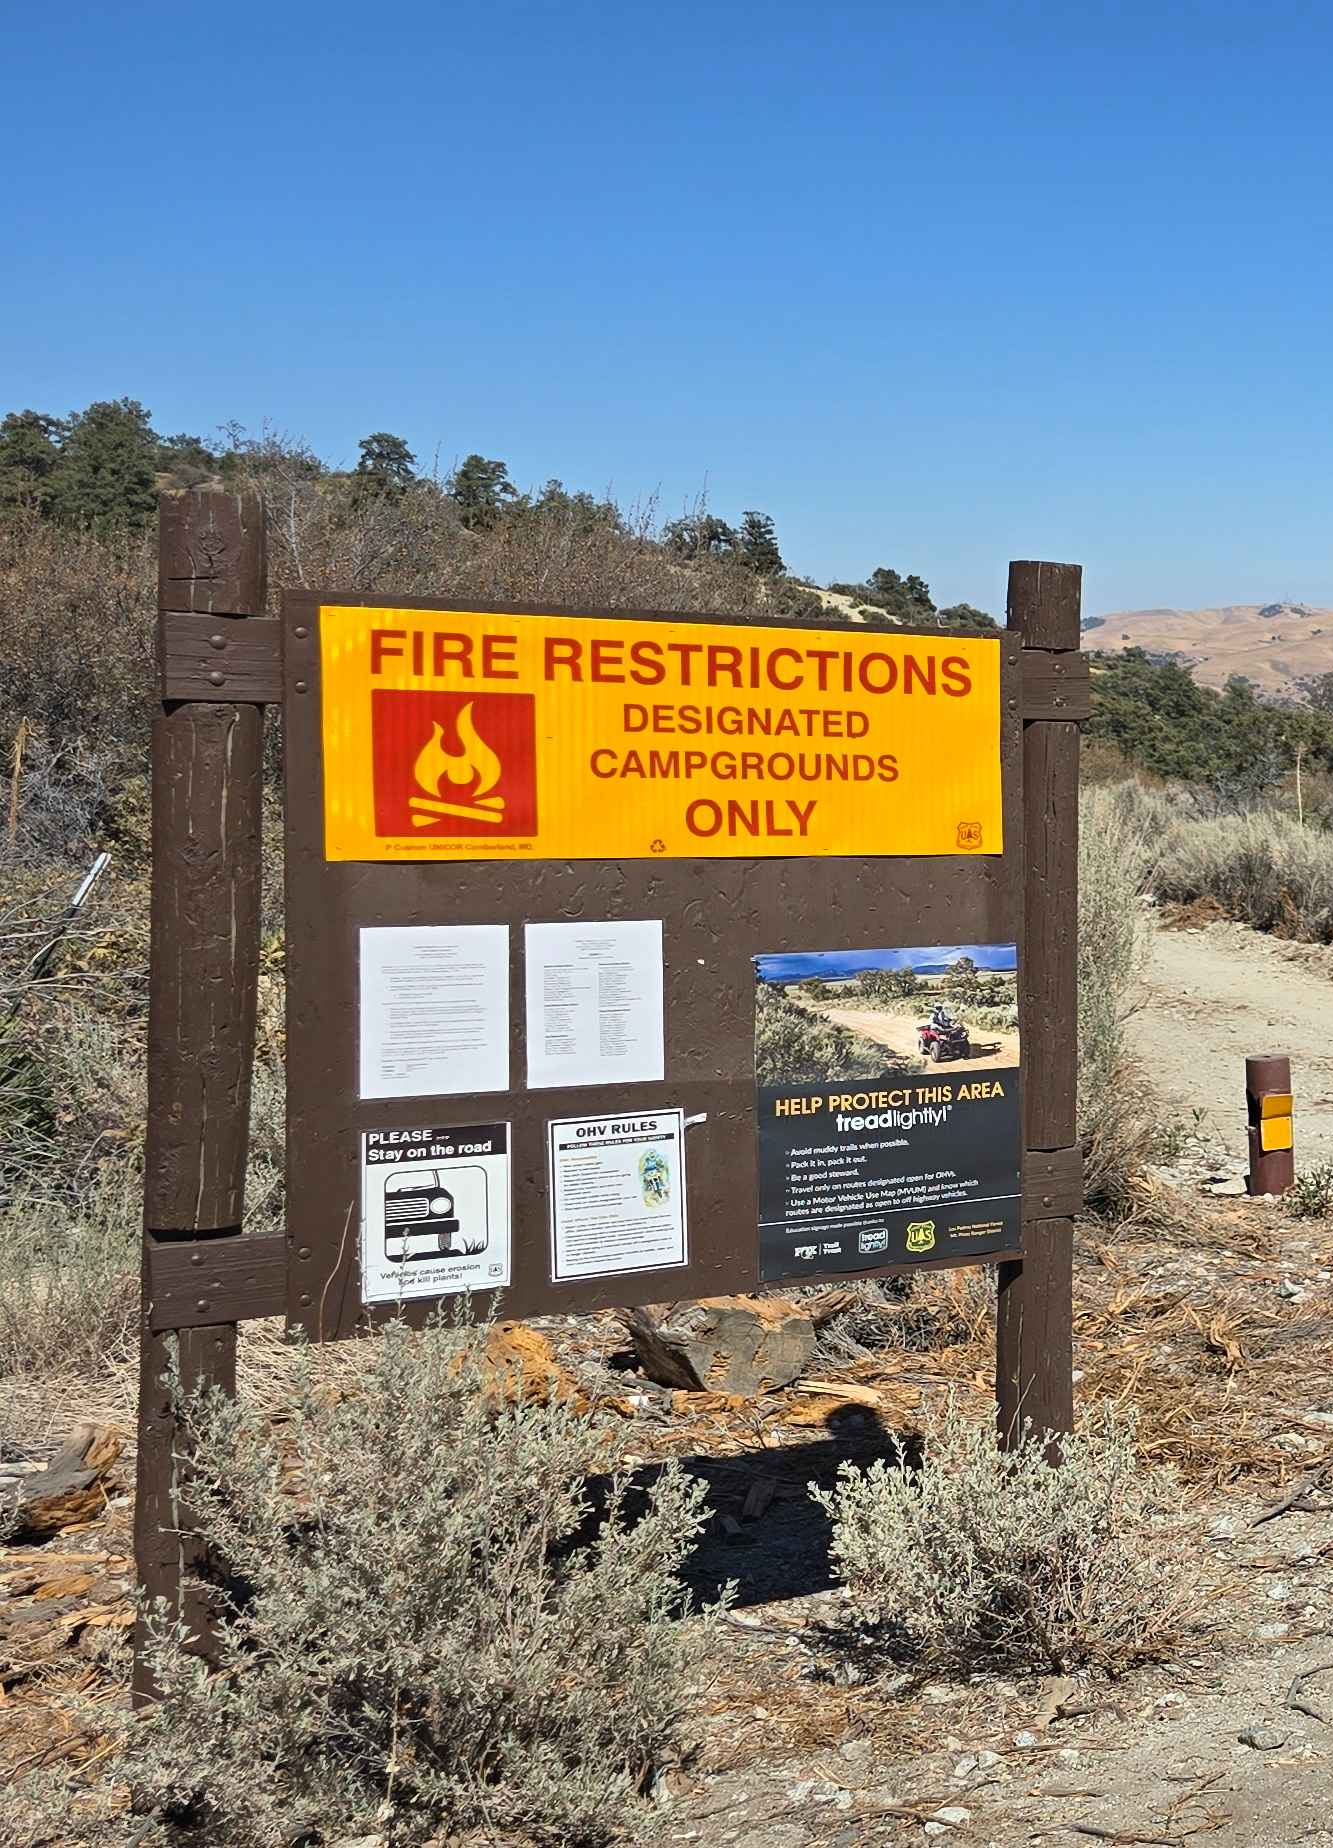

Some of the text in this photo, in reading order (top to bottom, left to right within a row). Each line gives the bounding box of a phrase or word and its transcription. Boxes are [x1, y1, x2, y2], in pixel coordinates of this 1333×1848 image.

[371, 629, 972, 698] FIRE RESTRICTIONS
[623, 703, 870, 738] DESIGNATED
[590, 749, 899, 782] CAMPGROUNDS
[686, 799, 817, 838] ONLY
[775, 1081, 1005, 1117] HELP PROTECT THIS AREA
[368, 1129, 433, 1145] PLEASE
[576, 1120, 658, 1138] OHV RULES
[368, 1140, 492, 1162] Stay on the road
[813, 1145, 839, 1155] muddy
[839, 1143, 858, 1151] trails
[859, 1142, 879, 1150] when
[791, 1161, 809, 1169] Pack
[810, 1159, 816, 1167] it
[828, 1157, 845, 1167] pack
[791, 1174, 801, 1182] Be
[808, 1171, 828, 1181] good
[791, 1185, 813, 1194] Travel
[814, 1184, 831, 1193] only
[867, 1175, 905, 1187] designated
[906, 1175, 924, 1183] open
[785, 1207, 810, 1216] routes
[811, 1206, 823, 1214] are
[824, 1203, 865, 1213] designated
[865, 1201, 874, 1209] as
[874, 1199, 892, 1208] open
[893, 1197, 901, 1205] to
[912, 1194, 940, 1204] highway
[790, 1199, 806, 1207] Use
[812, 1196, 837, 1206] Motor
[837, 1194, 864, 1202] Vehicle
[865, 1191, 880, 1199] Use
[880, 1189, 896, 1198] Map
[928, 1183, 940, 1192] and
[417, 1275, 431, 1283] kill
[419, 1266, 446, 1275] cause
[448, 1263, 481, 1273] erosion
